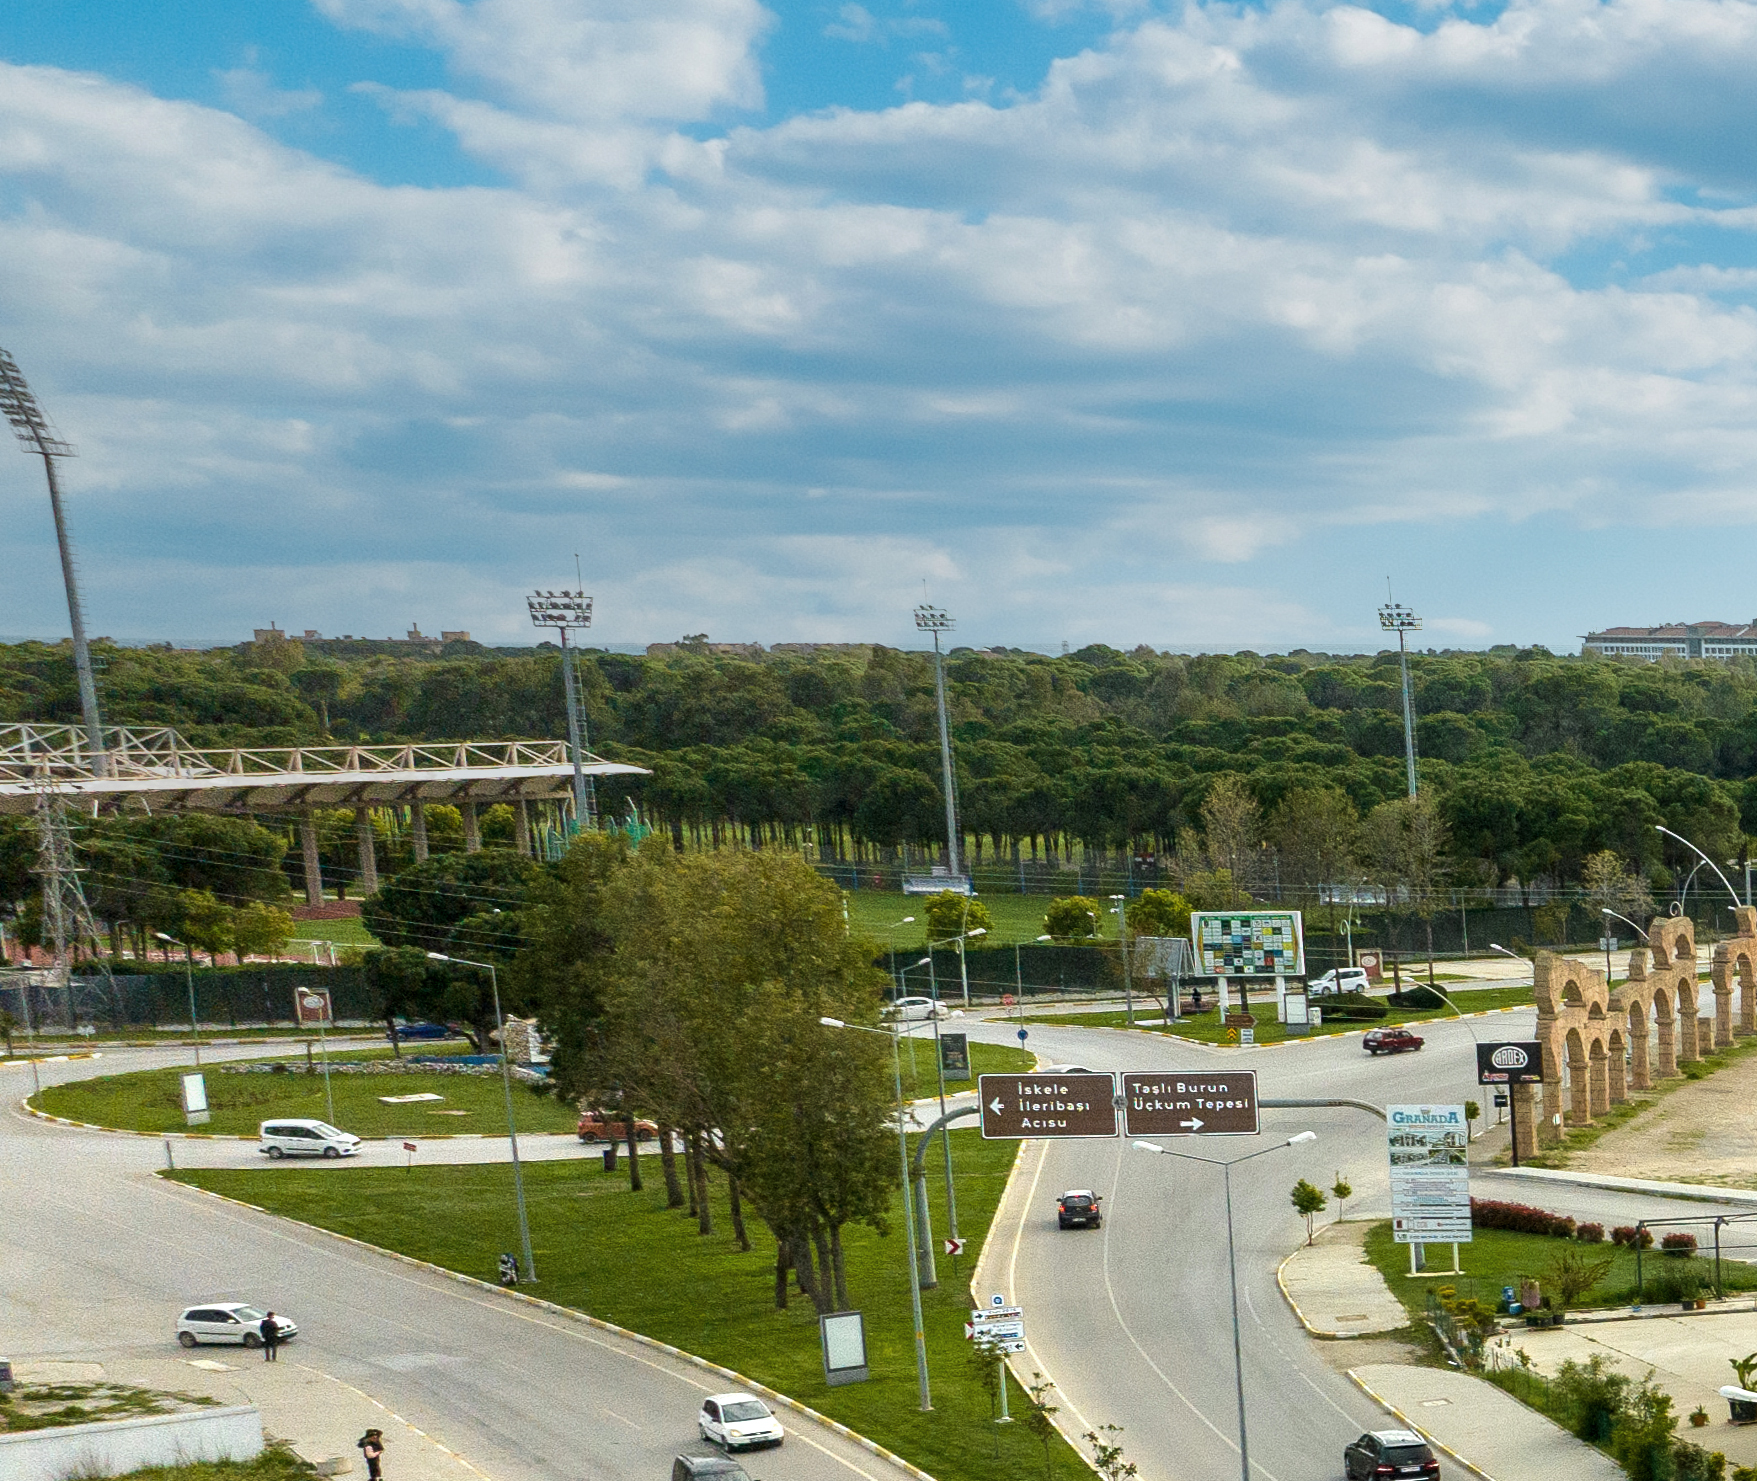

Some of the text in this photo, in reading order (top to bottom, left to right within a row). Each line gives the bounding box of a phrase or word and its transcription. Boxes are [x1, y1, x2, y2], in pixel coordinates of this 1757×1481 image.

[1495, 1049, 1525, 1065] ARDEX
[1018, 1082, 1069, 1095] İskele
[1132, 1083, 1228, 1095] Taşlı Burun
[1019, 1100, 1090, 1112] İleribaşı
[1195, 1099, 1249, 1111] Tepesi
[1021, 1118, 1067, 1128] Acısu
[1393, 1112, 1459, 1124] GRANADA
